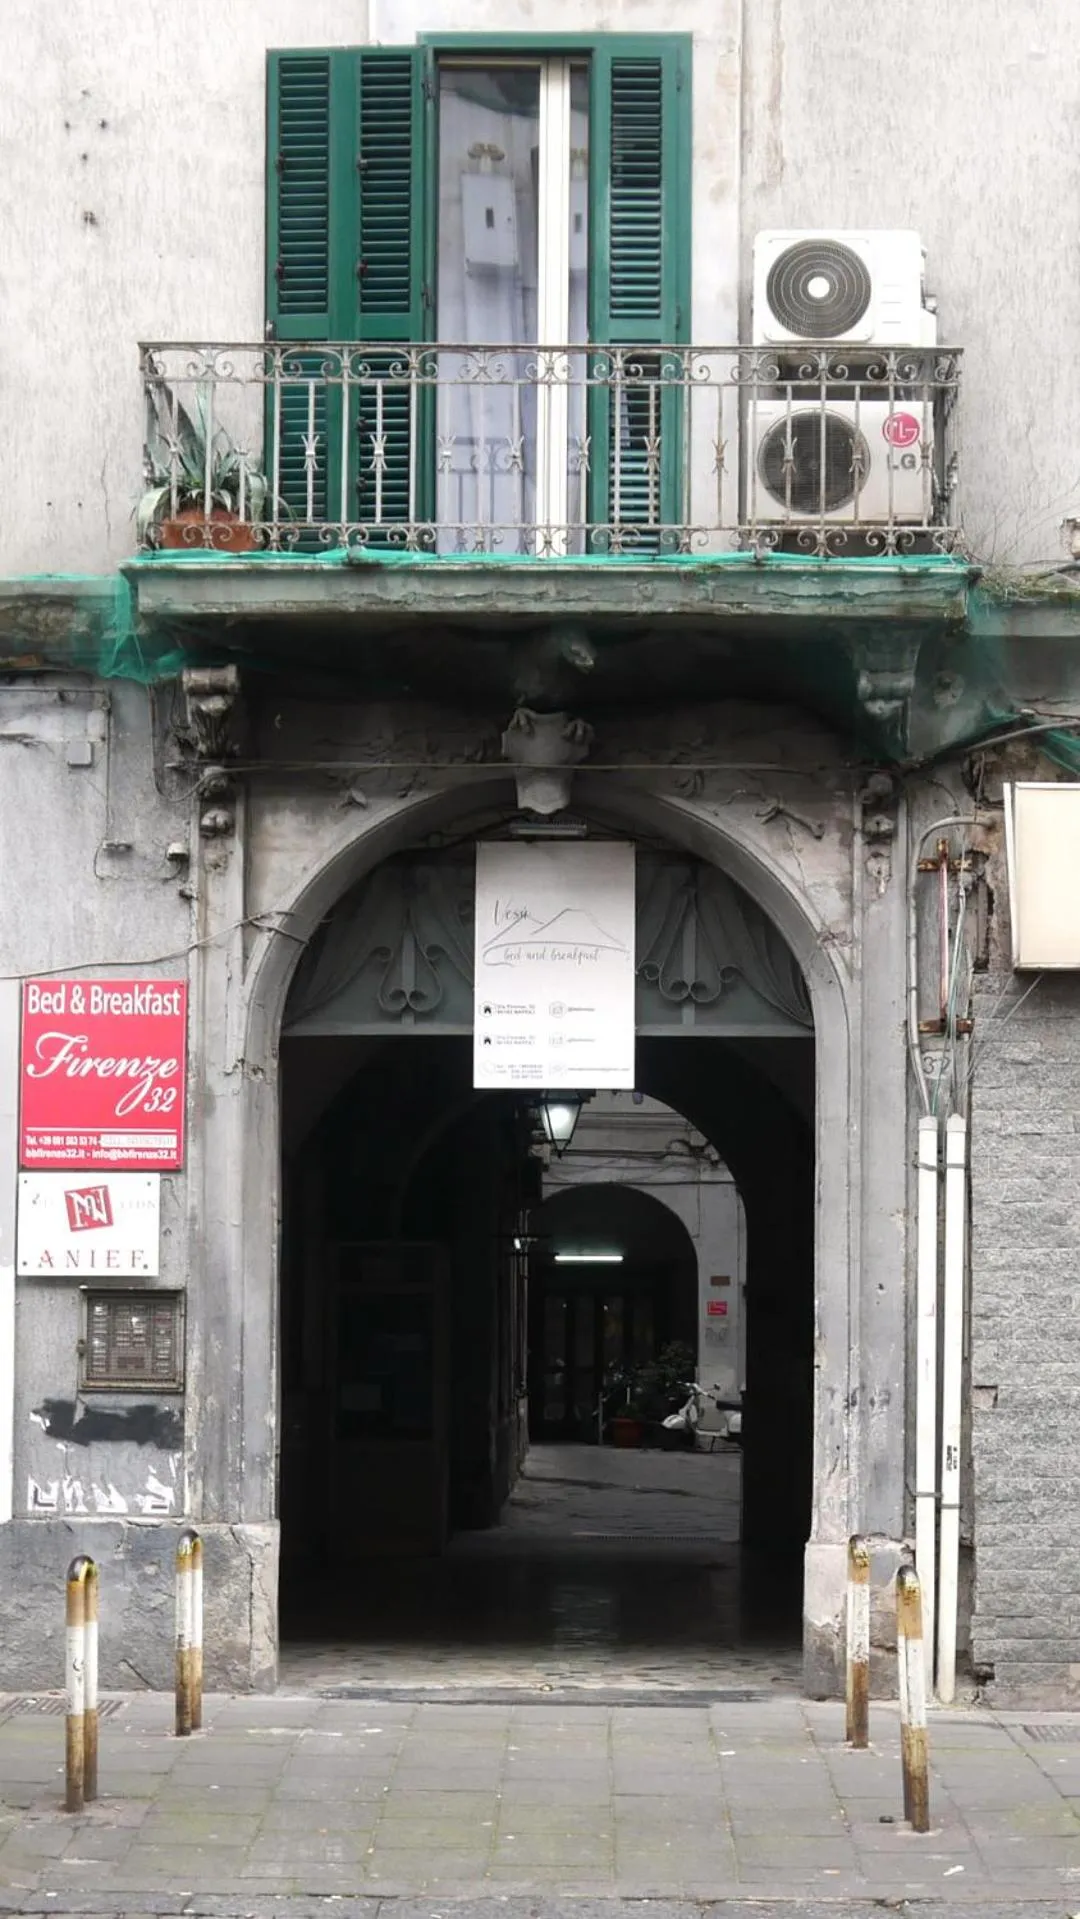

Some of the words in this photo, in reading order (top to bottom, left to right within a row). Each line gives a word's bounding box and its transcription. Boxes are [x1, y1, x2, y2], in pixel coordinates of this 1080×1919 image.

[887, 453, 916, 470] LG
[28, 984, 66, 1015] Bed
[70, 984, 85, 1014] &
[90, 984, 181, 1016] Breakfast
[26, 1031, 179, 1116] Firenze
[143, 1086, 178, 1112] 32
[36, 1249, 145, 1269] ANIEF
